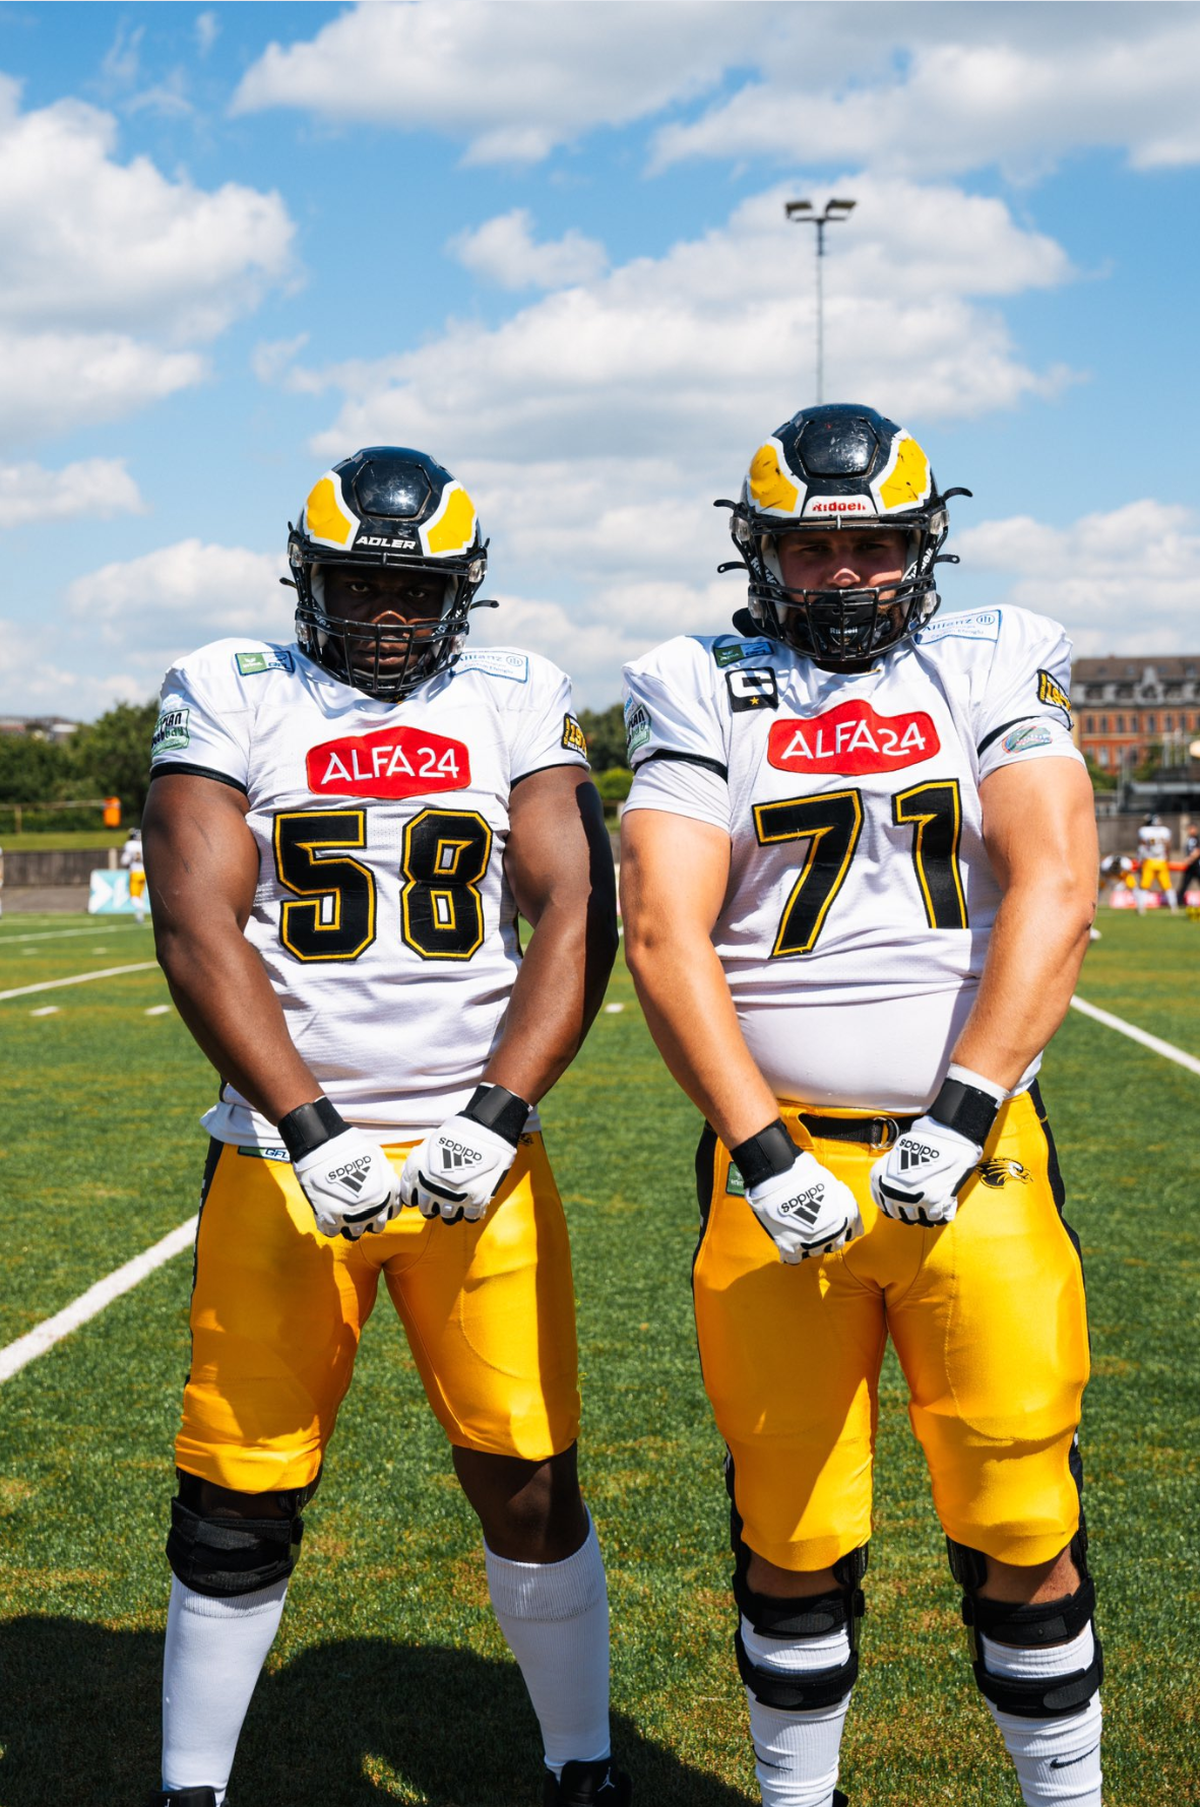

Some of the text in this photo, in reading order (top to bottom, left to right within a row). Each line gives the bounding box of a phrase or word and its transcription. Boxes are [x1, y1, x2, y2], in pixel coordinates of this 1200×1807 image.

[813, 502, 866, 511] Riddel
[355, 536, 416, 550] ADLER
[729, 671, 774, 698] C
[781, 719, 926, 760] ALFA24
[321, 745, 460, 785] ALFA24
[752, 778, 969, 960] 71
[273, 808, 494, 964] 58
[438, 1136, 483, 1161] adidas
[899, 1138, 940, 1159] adidas
[328, 1155, 372, 1180] adidas
[781, 1182, 825, 1213] adidas
